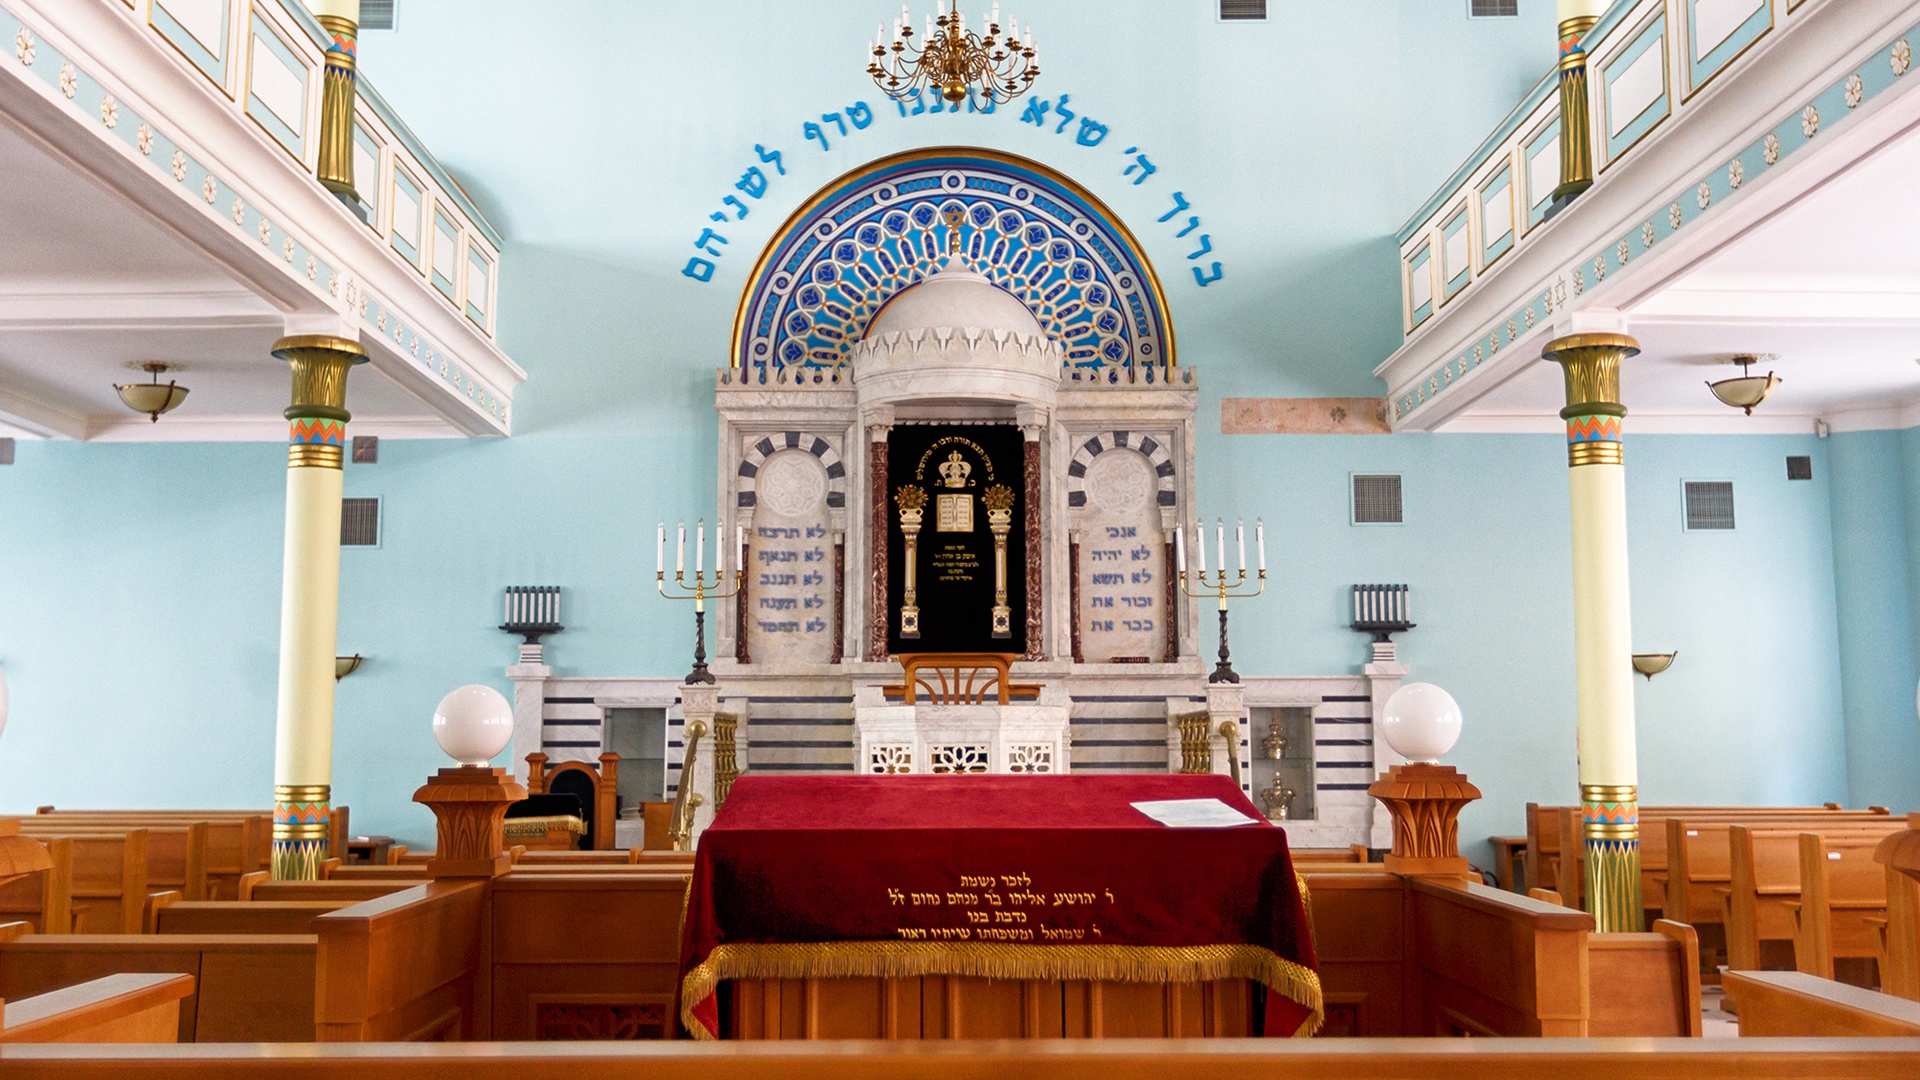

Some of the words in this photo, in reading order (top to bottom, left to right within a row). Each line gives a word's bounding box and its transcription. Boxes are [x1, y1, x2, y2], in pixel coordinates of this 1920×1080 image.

[803, 100, 873, 152] טרף
[1019, 93, 1109, 147] שלא
[682, 143, 786, 283] לשניהם
[1157, 191, 1223, 288] ברוך
[758, 527, 800, 539] תרצח
[806, 523, 826, 538] לא
[1105, 526, 1137, 538] אנכי
[759, 550, 798, 566] תנאף
[804, 546, 824, 561] לא
[1092, 549, 1122, 561] יהיה
[1131, 544, 1151, 561] לא
[803, 570, 823, 585] לא
[1092, 573, 1125, 585] תשא
[1131, 568, 1152, 584] לא
[804, 594, 824, 609] לא
[1091, 596, 1114, 608] את
[1121, 596, 1153, 608] זכור
[758, 621, 800, 633] תחמד
[806, 616, 826, 632] לא
[1091, 620, 1114, 632] את
[960, 875, 996, 887] נשמת
[1001, 871, 1032, 887] לזכר
[910, 892, 941, 906] נחום
[946, 892, 979, 905] מנחם
[1008, 888, 1046, 905] אליהו
[1052, 892, 1096, 906] יהושע
[967, 911, 990, 923] בנו
[995, 911, 1027, 923] נדבת
[976, 928, 1034, 940] ומשפחתו
[1040, 923, 1085, 939] שמואל
